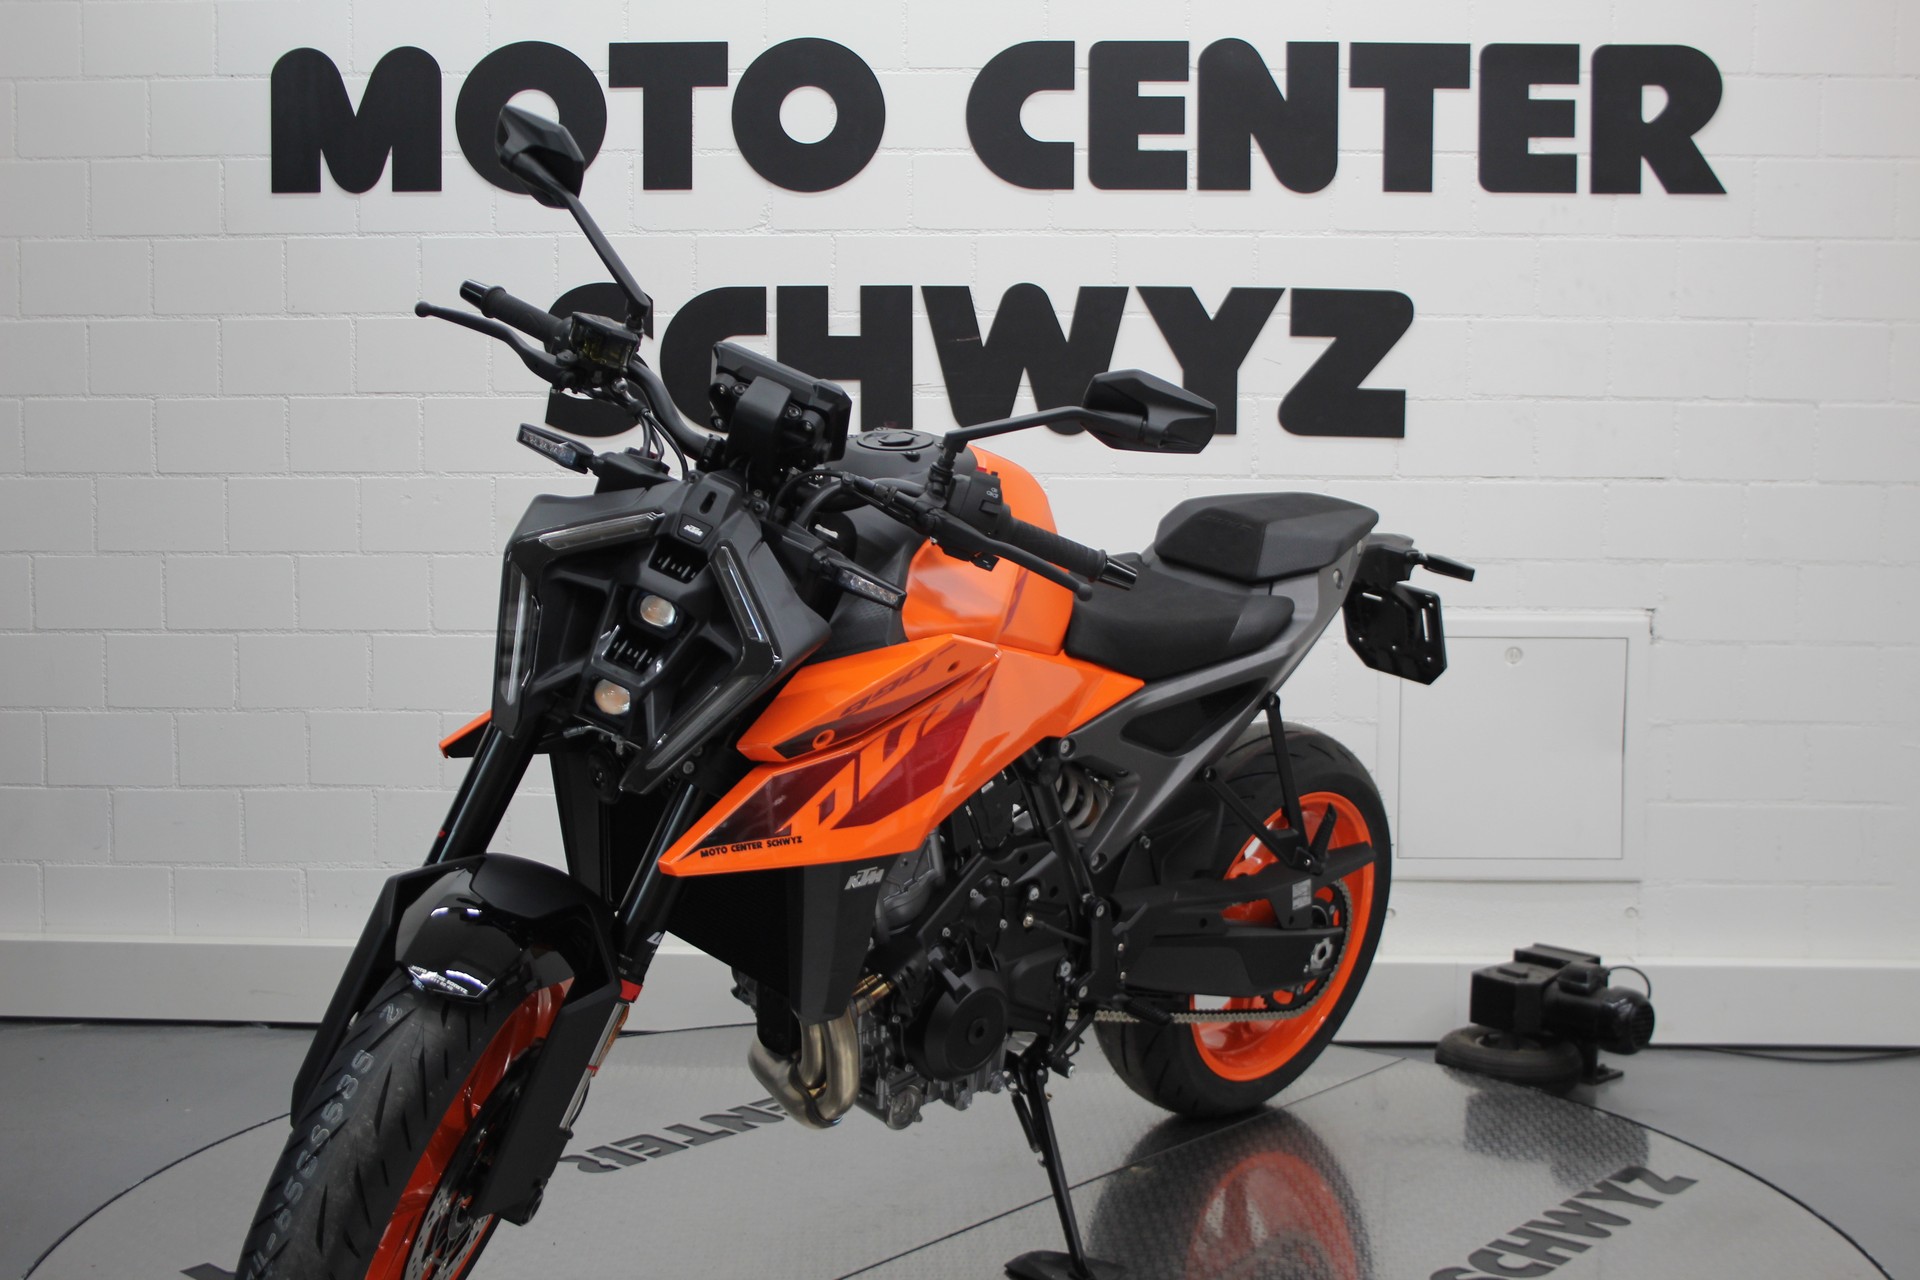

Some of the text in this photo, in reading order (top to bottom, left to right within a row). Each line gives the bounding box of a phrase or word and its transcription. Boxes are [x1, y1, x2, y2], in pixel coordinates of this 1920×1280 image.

[271, 37, 1727, 195] MOTO CENTER
[545, 282, 1415, 440] SCHWYZ
[700, 835, 803, 858] MOTO CENTER SCHWYZ
[844, 866, 885, 890] KTM
